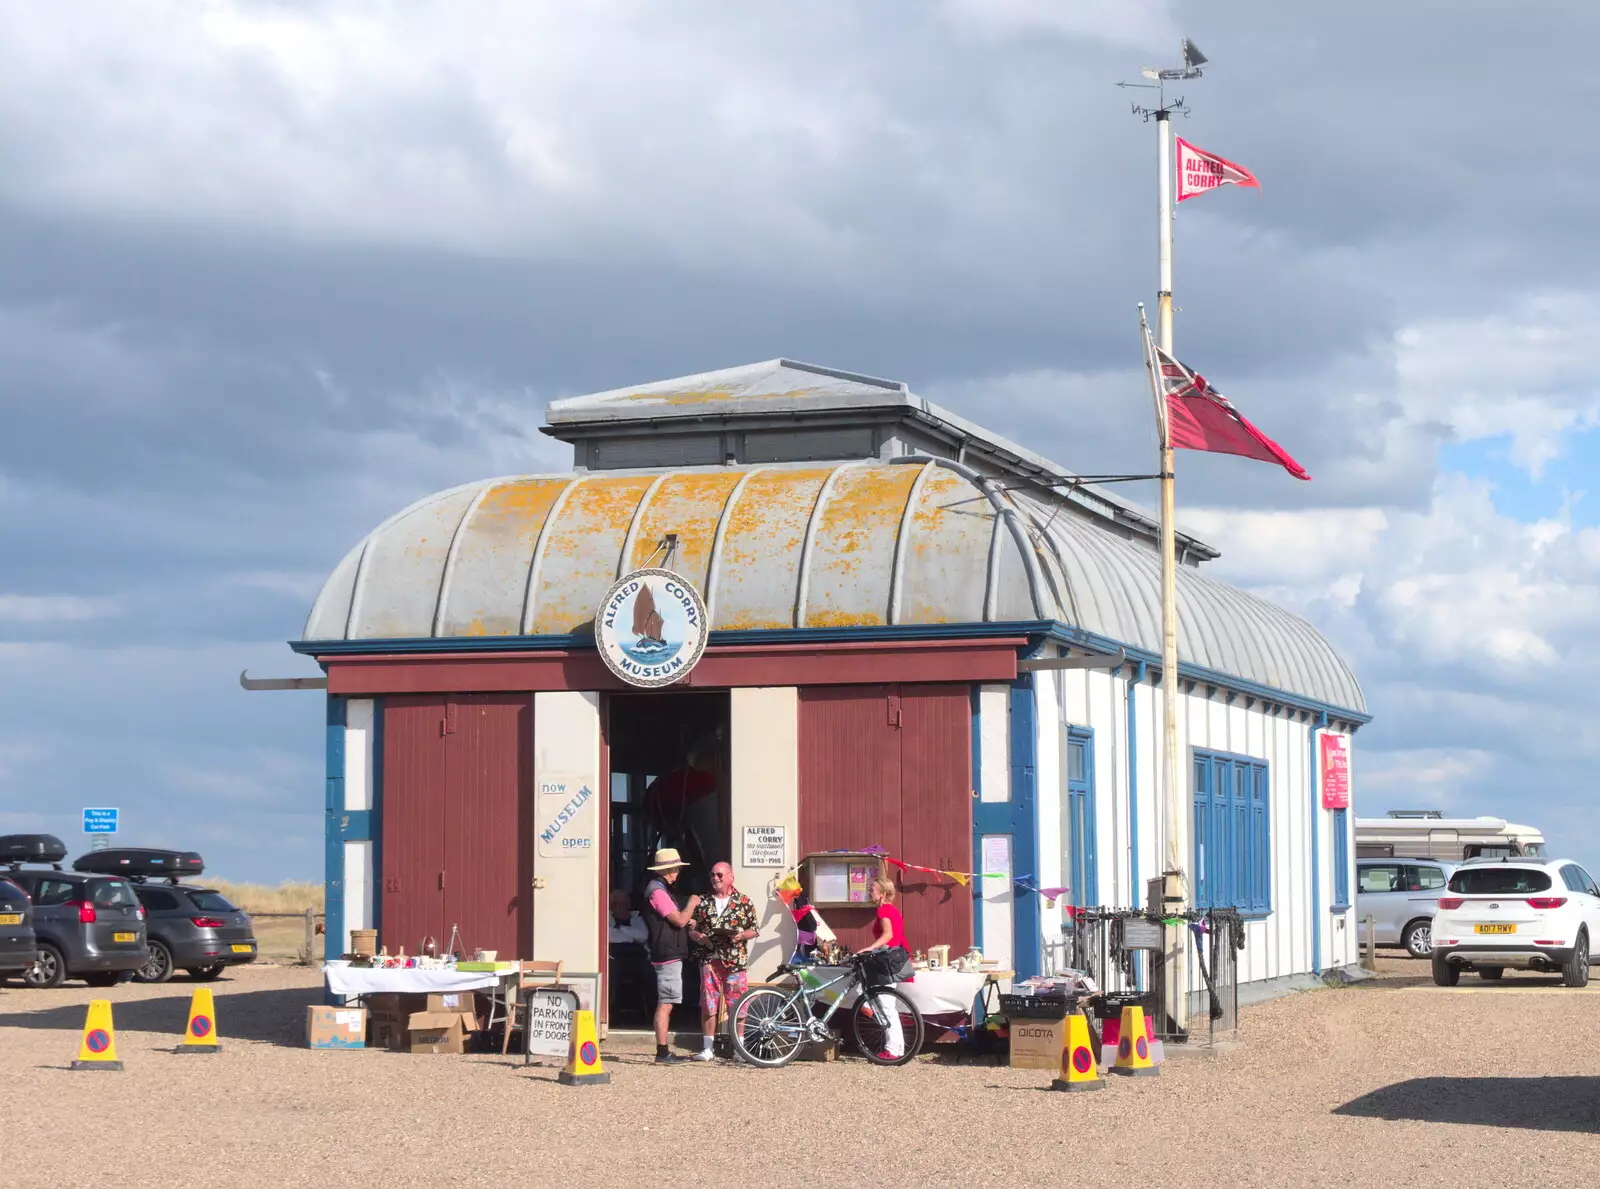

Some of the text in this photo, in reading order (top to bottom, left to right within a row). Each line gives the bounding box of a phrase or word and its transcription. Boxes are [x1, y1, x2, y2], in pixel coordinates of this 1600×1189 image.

[1186, 158, 1224, 174] ALFRED
[1187, 174, 1224, 188] CORRY
[604, 581, 639, 629] ALFRED
[664, 582, 698, 628] CORRY
[619, 656, 683, 677] MUSEUM
[542, 783, 566, 793] now
[540, 784, 593, 844] MUSEUM
[562, 837, 591, 848] open
[1497, 924, 1513, 933] RWY
[547, 995, 562, 1007] NO
[534, 1020, 572, 1031] IN FRONT
[533, 1029, 543, 1038] OF
